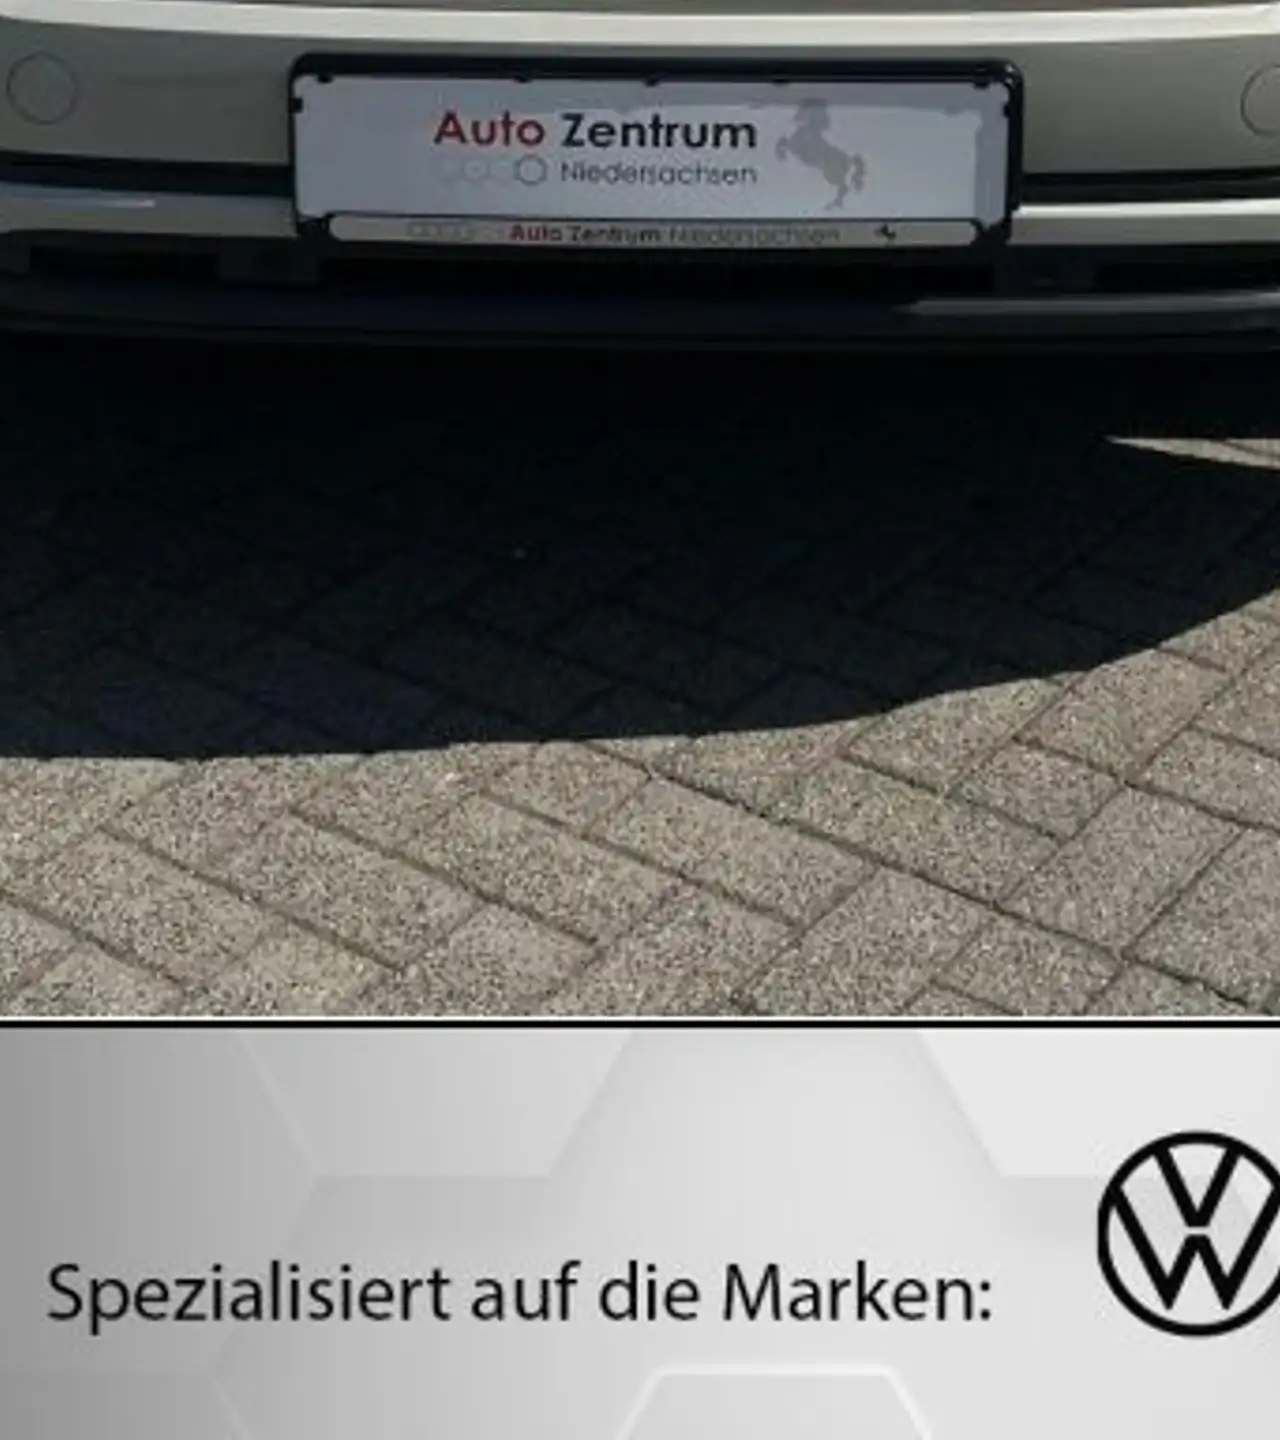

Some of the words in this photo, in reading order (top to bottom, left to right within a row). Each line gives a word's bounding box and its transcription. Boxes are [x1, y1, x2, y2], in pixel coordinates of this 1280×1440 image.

[433, 109, 547, 148] Auto
[561, 112, 757, 150] Zentrum
[559, 160, 759, 187] Niedersachsen
[507, 224, 564, 243] Auto
[568, 225, 662, 245] Zentrum
